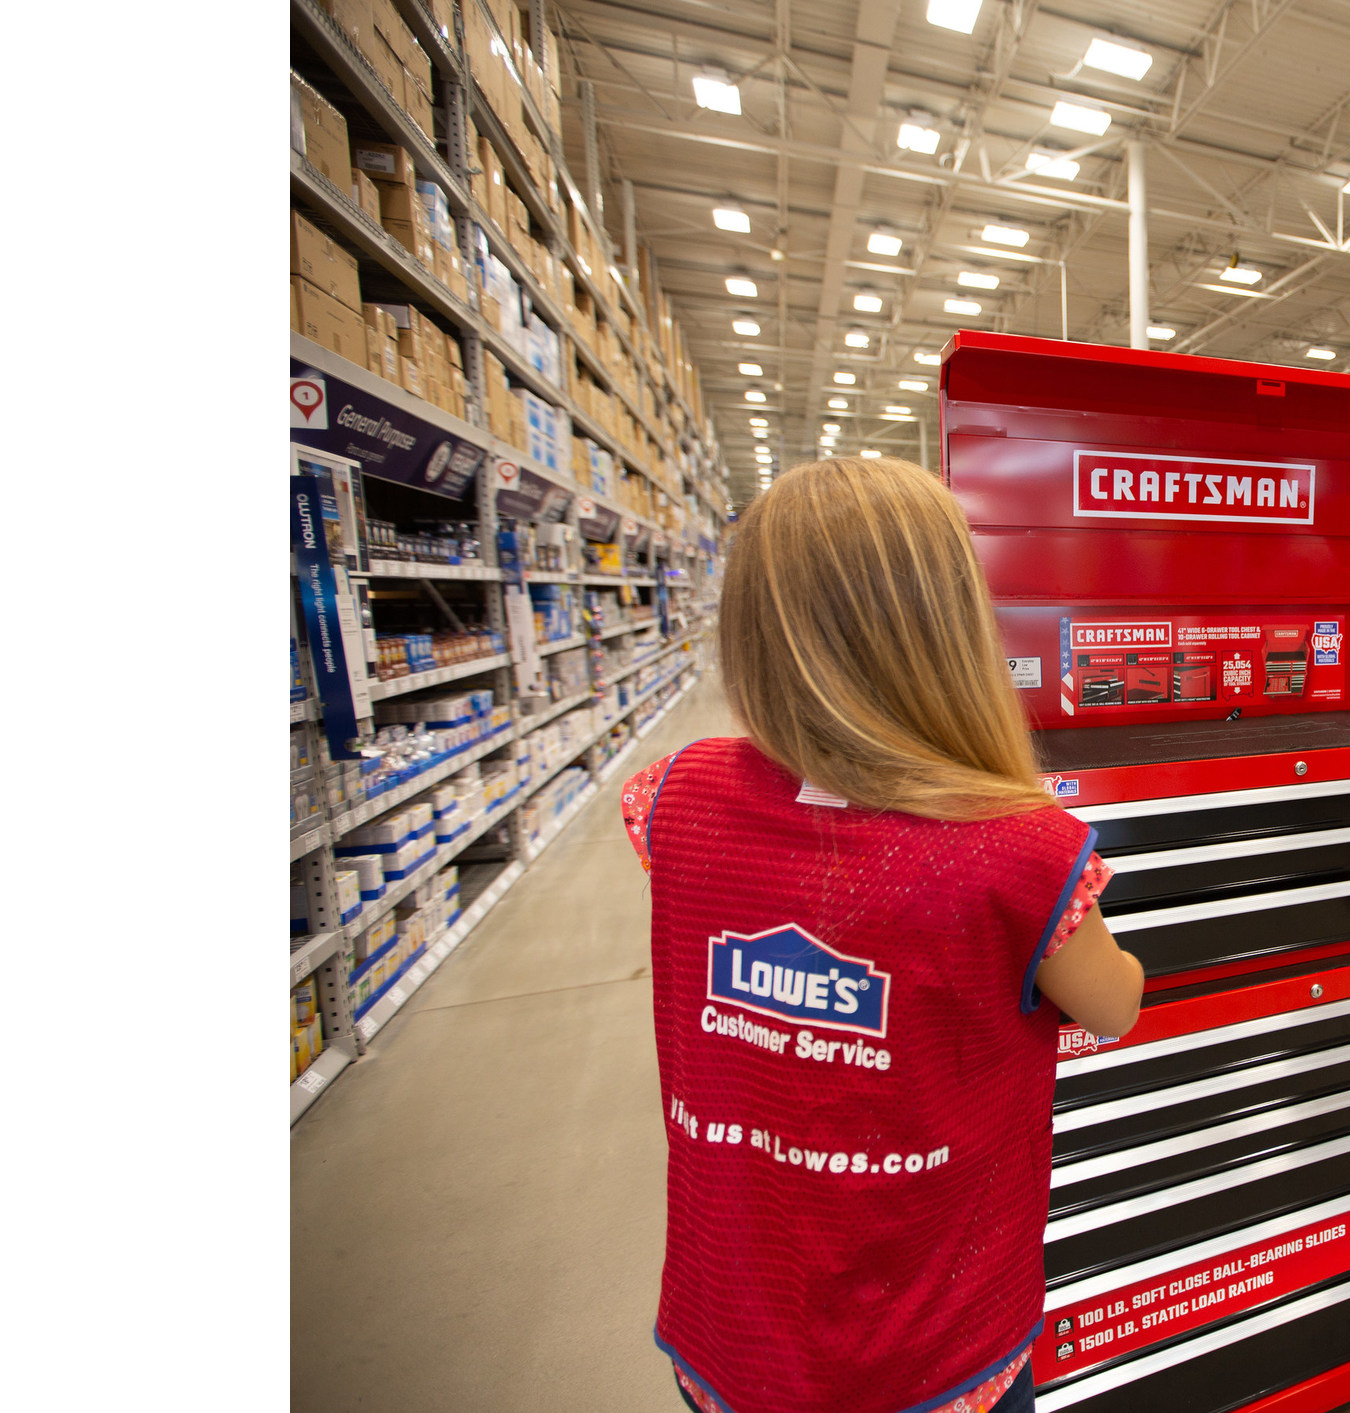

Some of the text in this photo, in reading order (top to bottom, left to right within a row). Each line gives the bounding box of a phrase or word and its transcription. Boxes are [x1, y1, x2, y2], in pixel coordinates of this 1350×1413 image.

[337, 404, 385, 439] General
[310, 564, 337, 673] The right light connects people
[1315, 636, 1338, 648] USA
[1223, 660, 1251, 670] 25,054
[1223, 675, 1251, 683] CAPACITY
[701, 1005, 791, 1055] Customer
[795, 1030, 892, 1071] Service
[1059, 1032, 1096, 1050] USA
[671, 1093, 950, 1174] Vit us at Lowes.com
[1078, 1224, 1346, 1328] 100 LB. SOFT CLOSE BALL-BEARING SLIDES
[1079, 1328, 1114, 1352] 1500
[1117, 1320, 1139, 1339] LB.
[1142, 1301, 1189, 1329] STATIC
[1191, 1288, 1226, 1312] LOAD
[1228, 1271, 1274, 1299] RATING
